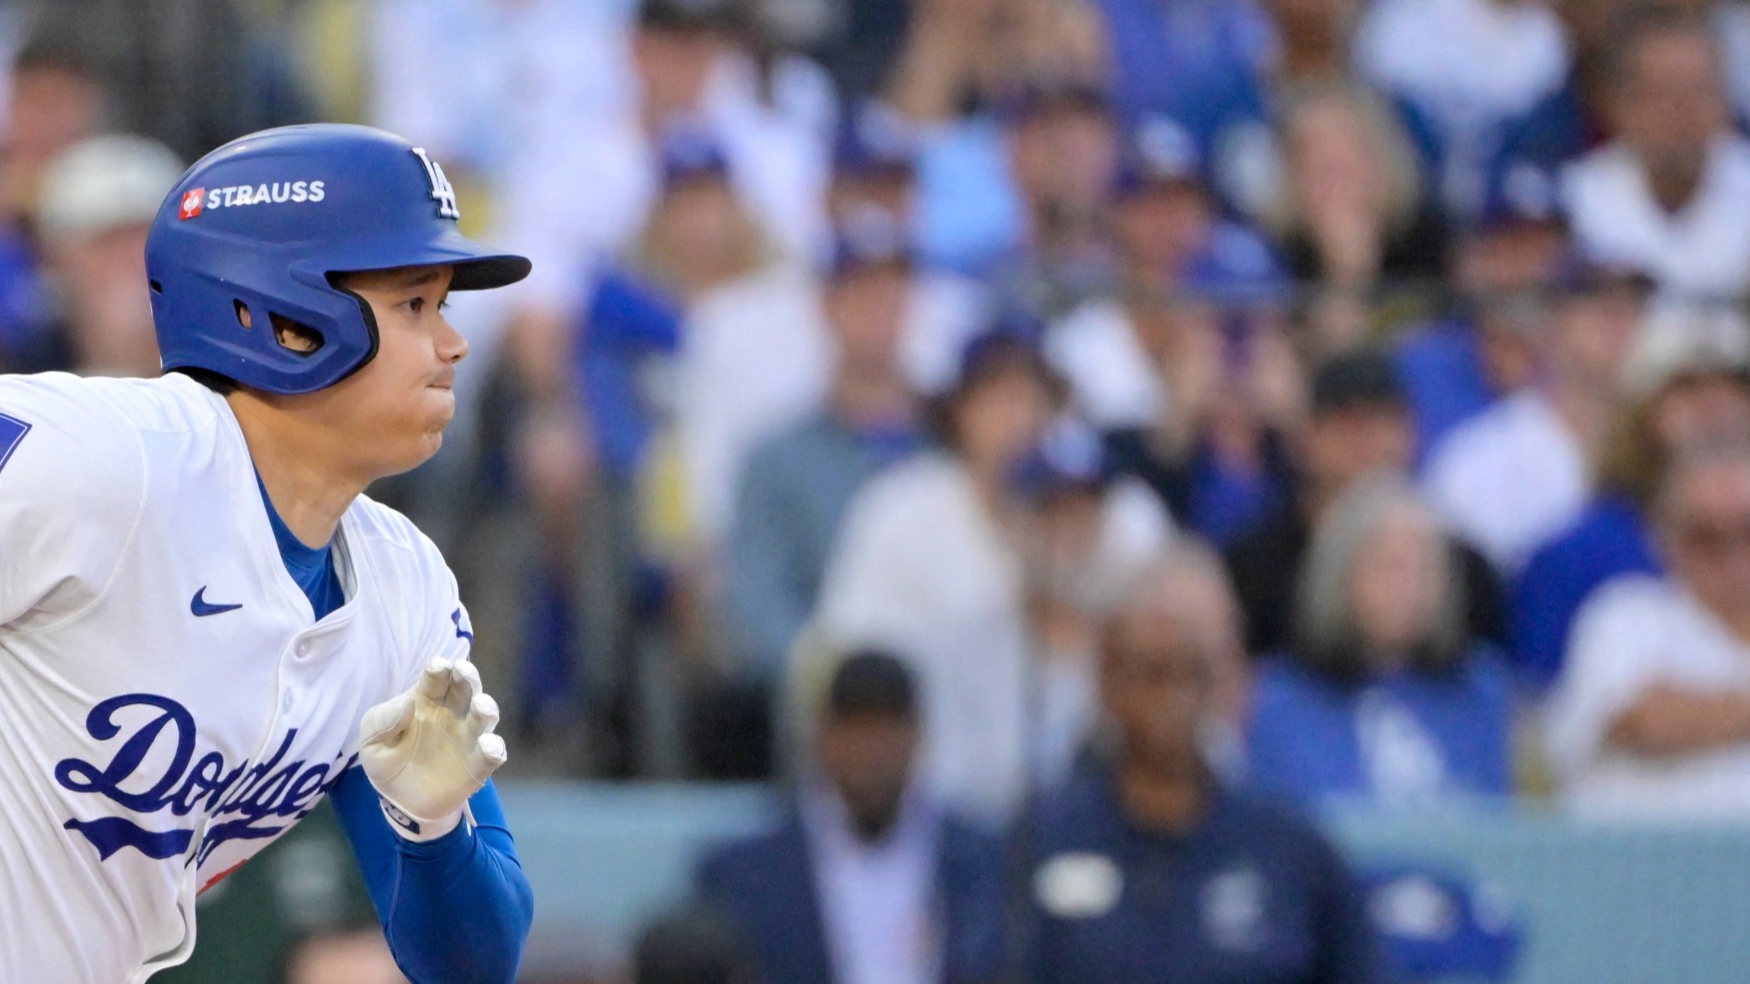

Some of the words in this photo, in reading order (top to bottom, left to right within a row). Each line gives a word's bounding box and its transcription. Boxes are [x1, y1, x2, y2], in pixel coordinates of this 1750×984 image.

[206, 180, 325, 210] STRAUSS
[412, 147, 460, 219] LA
[55, 694, 360, 866] Dodge
